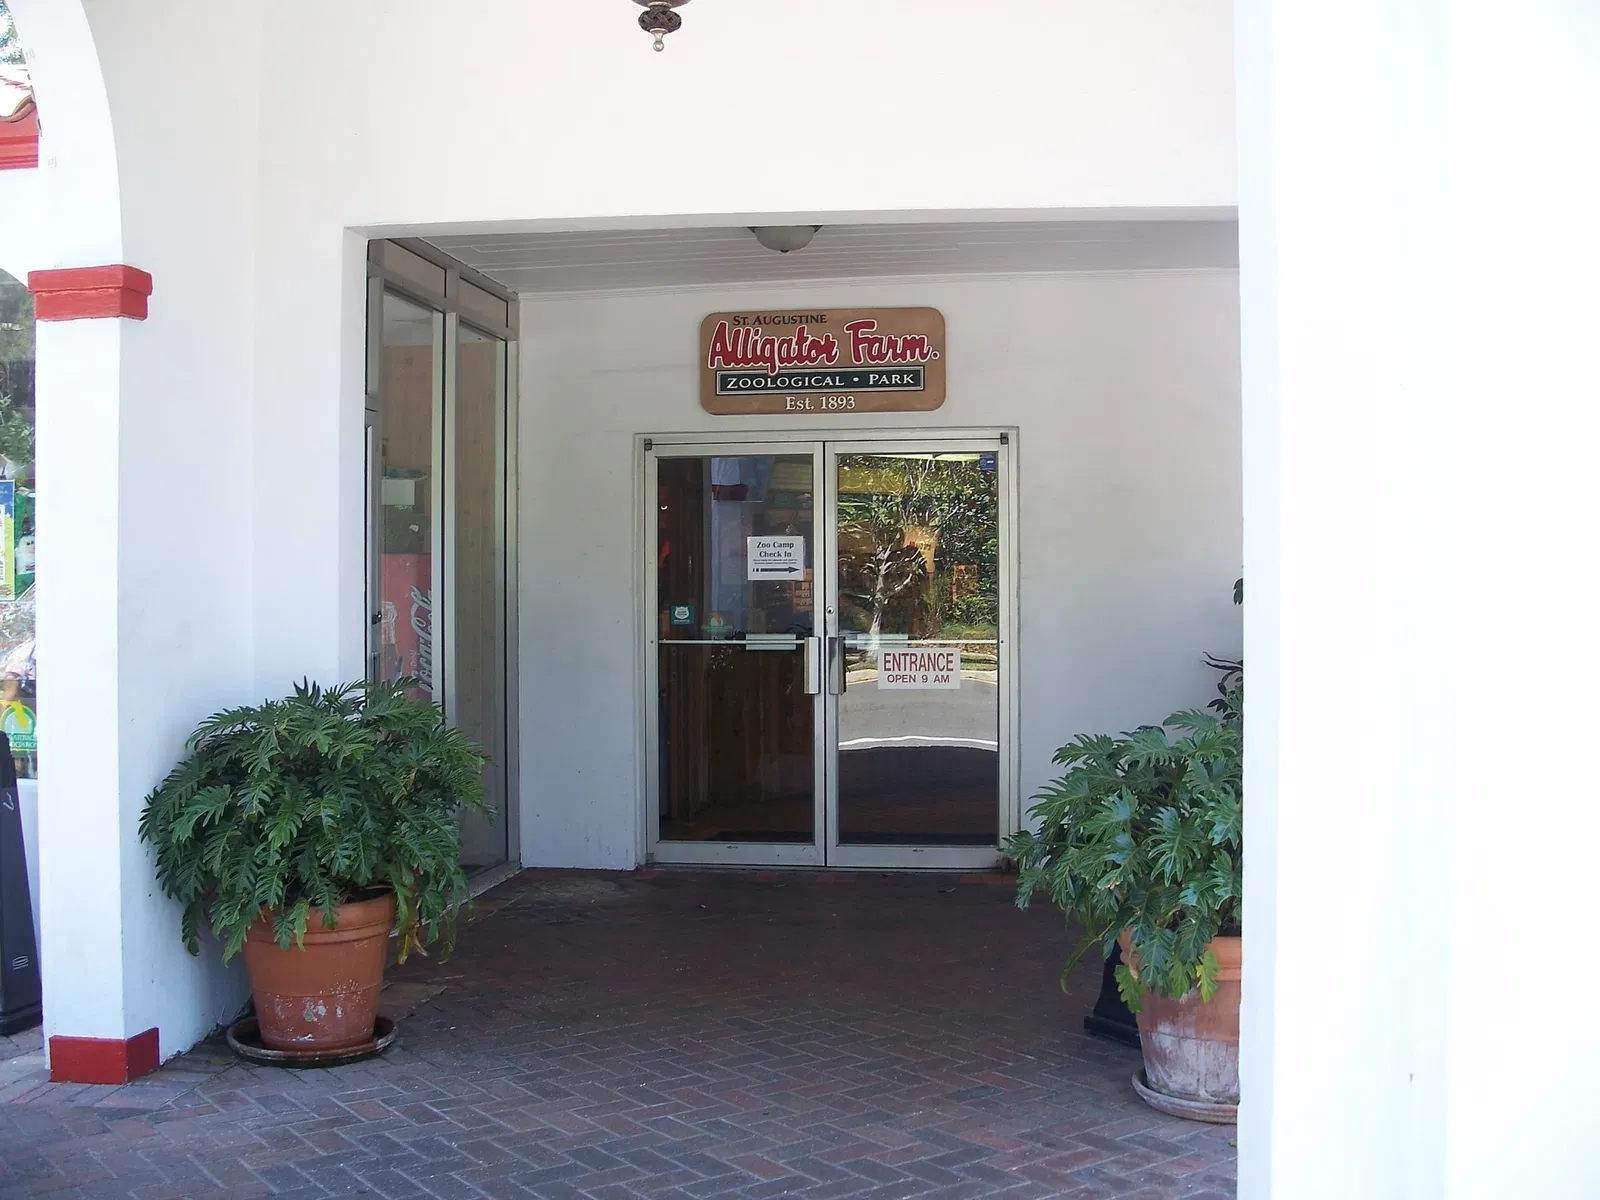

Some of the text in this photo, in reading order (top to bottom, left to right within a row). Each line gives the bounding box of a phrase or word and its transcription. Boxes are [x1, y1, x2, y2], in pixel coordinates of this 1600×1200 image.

[753, 314, 828, 325] AUGUSTINE
[708, 320, 839, 375] Alligator
[727, 374, 914, 389] ZOOLOGICAL PARK
[785, 396, 856, 410] Est. 1893
[759, 550, 792, 558] Check In
[883, 652, 954, 672] ENTRANCE
[887, 674, 950, 683] OPEN 9 AM
